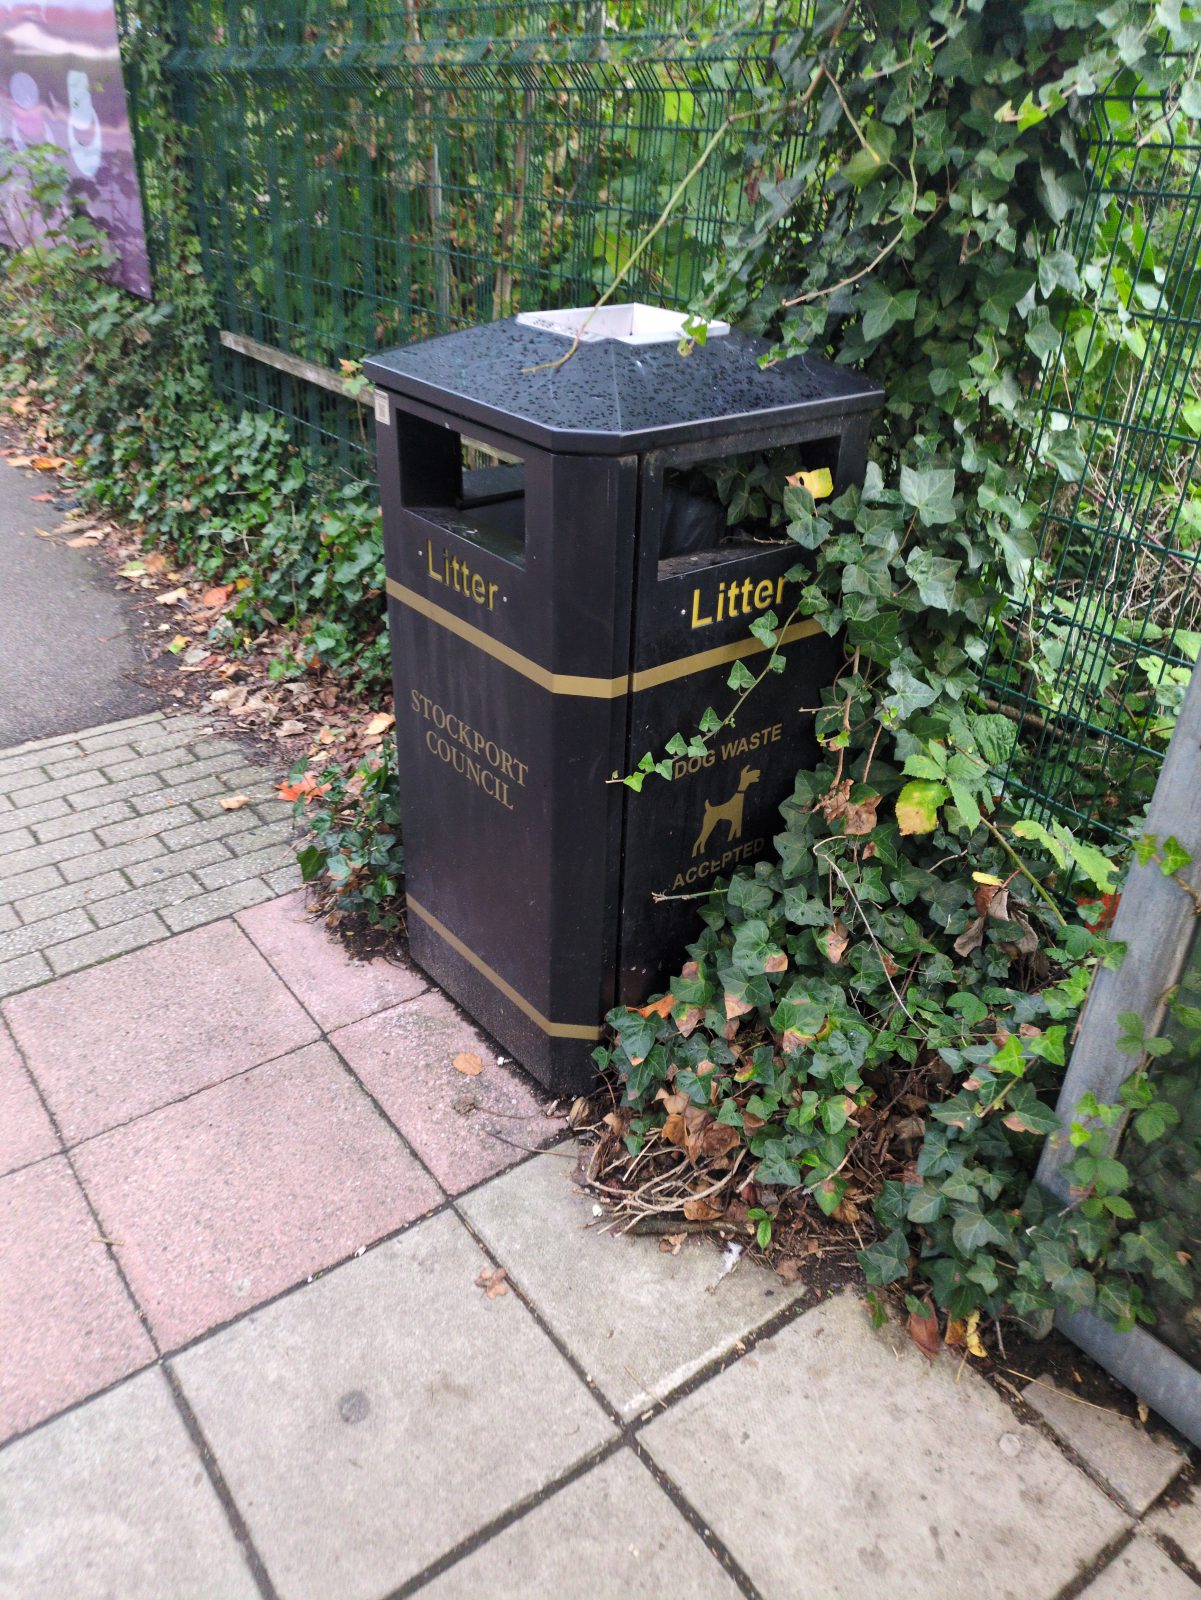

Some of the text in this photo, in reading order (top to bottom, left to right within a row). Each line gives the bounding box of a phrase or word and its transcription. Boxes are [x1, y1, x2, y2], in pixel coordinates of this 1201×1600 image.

[427, 540, 499, 610] Litter
[691, 575, 786, 628] Litter
[411, 690, 528, 787] STOCKPORT
[674, 723, 782, 779] DOG WASTE
[426, 731, 514, 810] COUNCIL
[672, 837, 765, 890] ACCEPTED
